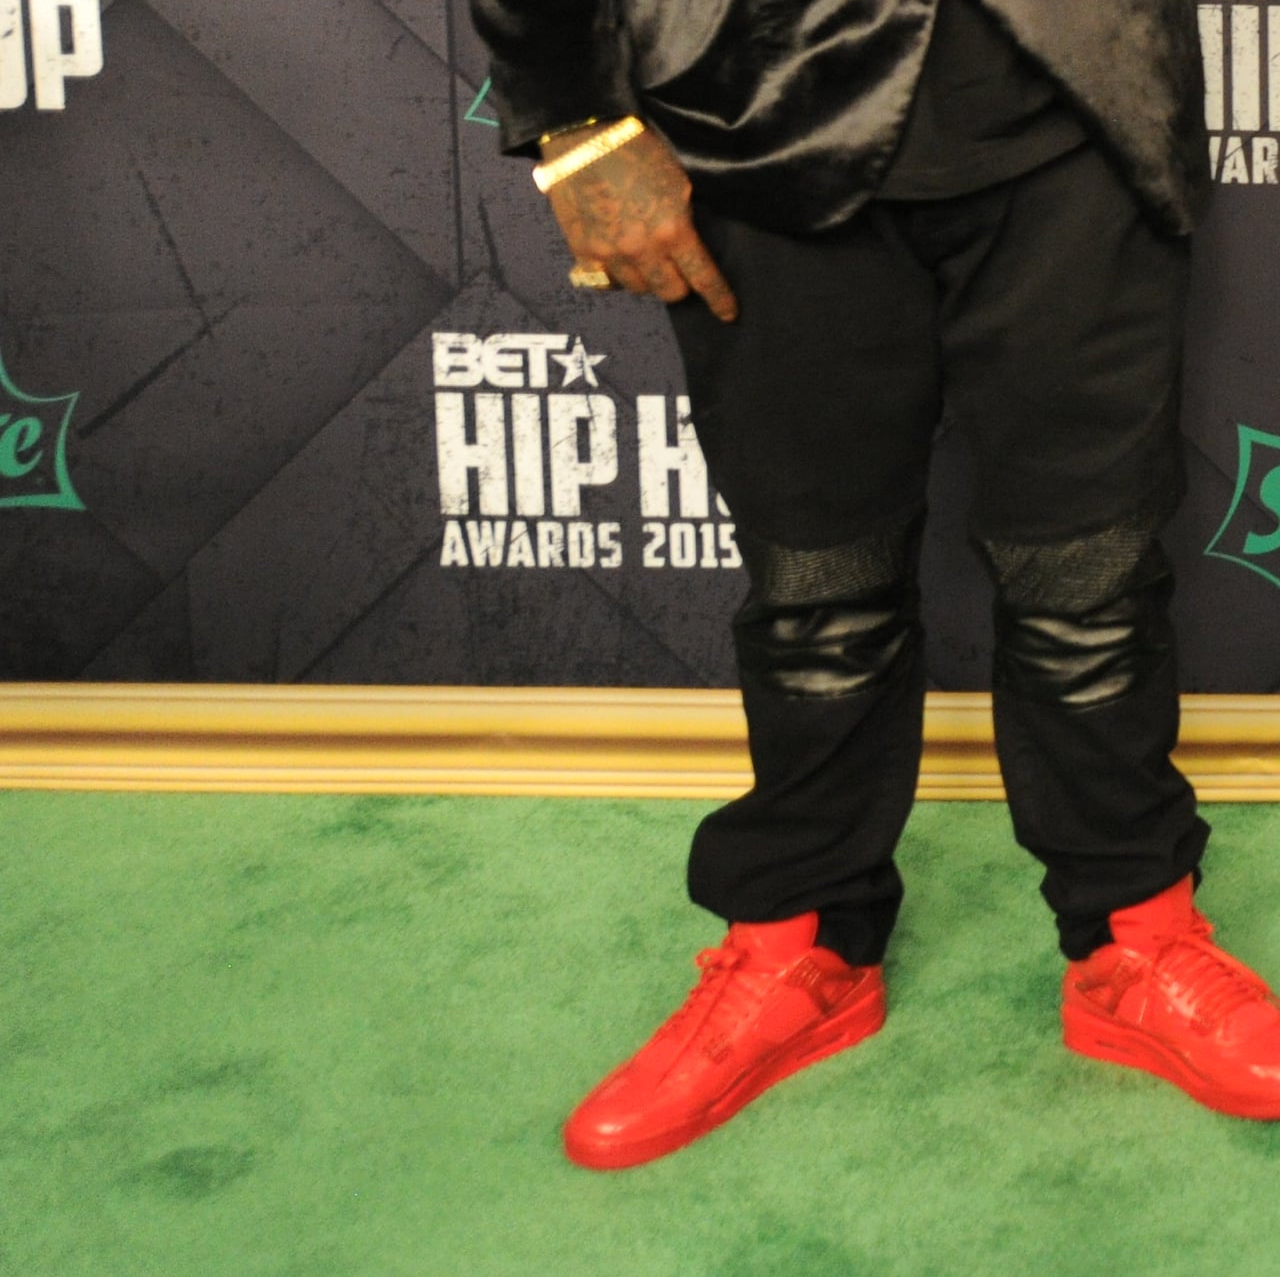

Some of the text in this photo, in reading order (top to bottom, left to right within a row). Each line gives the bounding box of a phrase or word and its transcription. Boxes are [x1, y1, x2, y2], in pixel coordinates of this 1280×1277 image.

[432, 332, 568, 388] BET
[435, 392, 618, 516] HIP
[440, 520, 744, 568] AWARDS 2015
